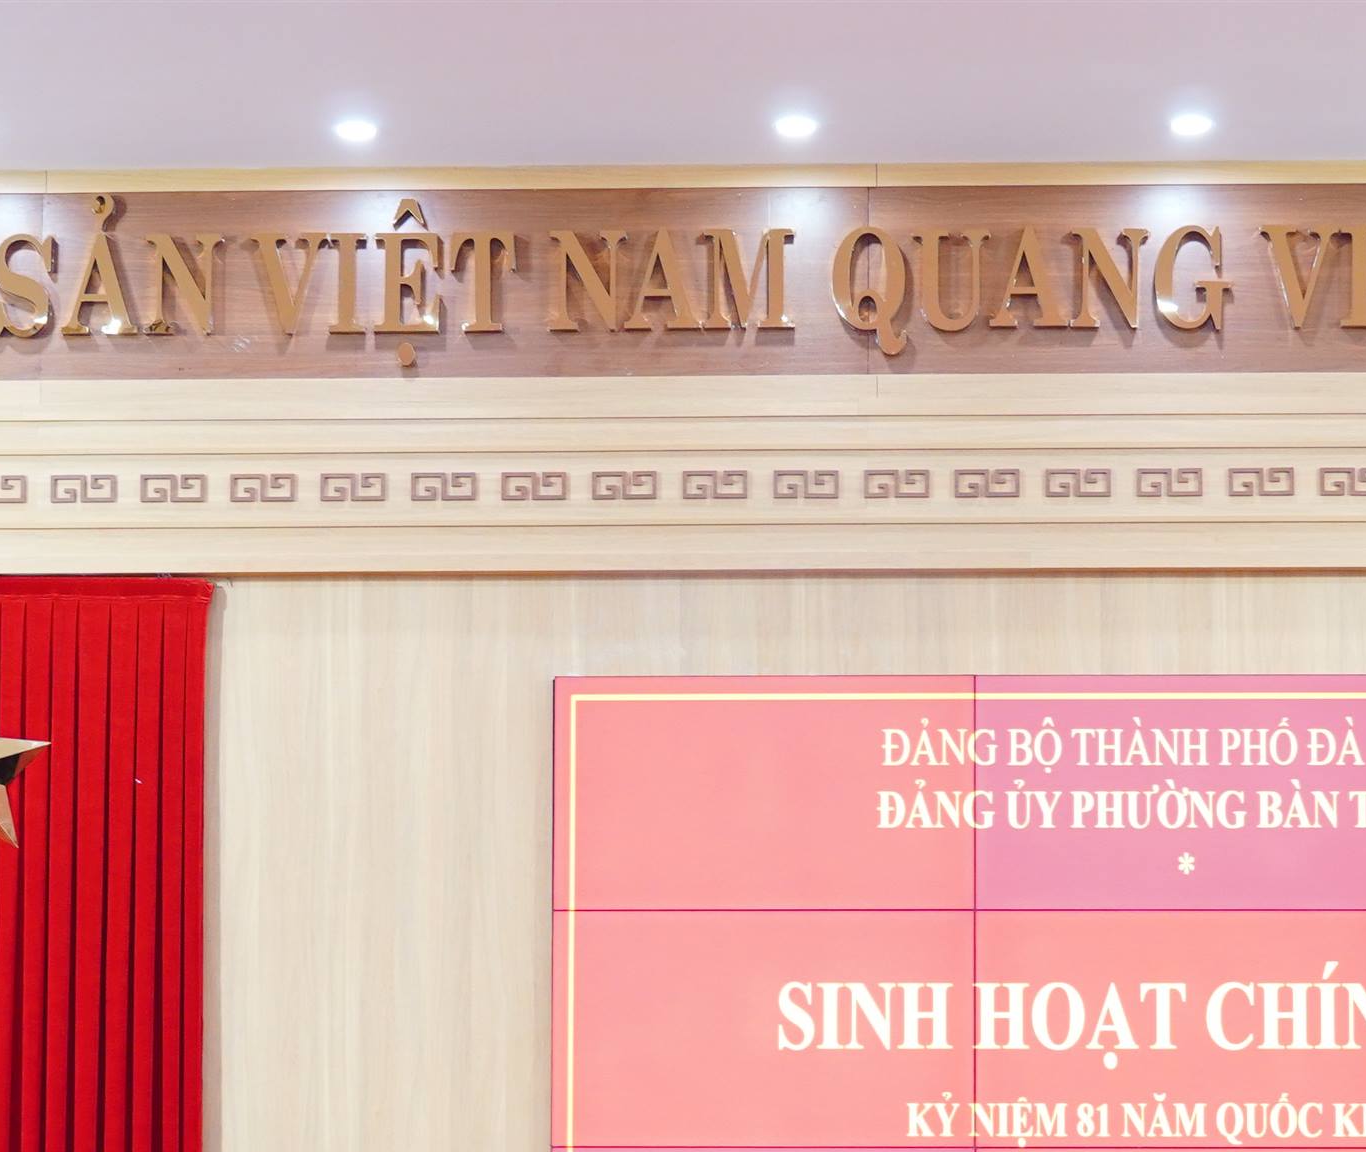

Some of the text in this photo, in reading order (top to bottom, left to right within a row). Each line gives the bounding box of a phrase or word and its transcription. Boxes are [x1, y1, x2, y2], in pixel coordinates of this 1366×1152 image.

[249, 198, 519, 367] VIỆT
[546, 226, 796, 332] NAM
[832, 224, 1235, 356] QUANG
[881, 717, 998, 766] ĐẢNG
[1007, 716, 1062, 774] BỘ
[1071, 716, 1209, 766] THÀNH
[1218, 716, 1298, 766] PHỐ
[1306, 716, 1366, 766] ĐÀ
[876, 778, 996, 829] ĐẢNG
[1004, 778, 1062, 829] ỦY
[1069, 778, 1247, 829] PHƯỜNG
[1255, 778, 1339, 829] BÀN
[776, 980, 953, 1052] SINH
[972, 980, 1187, 1070] HOẠT
[906, 1092, 960, 1137] KỶ
[968, 1096, 1068, 1148] NIỆM
[1076, 1102, 1112, 1138] 81
[1121, 1092, 1207, 1138] NĂM
[1215, 1092, 1323, 1145] QUỐC
